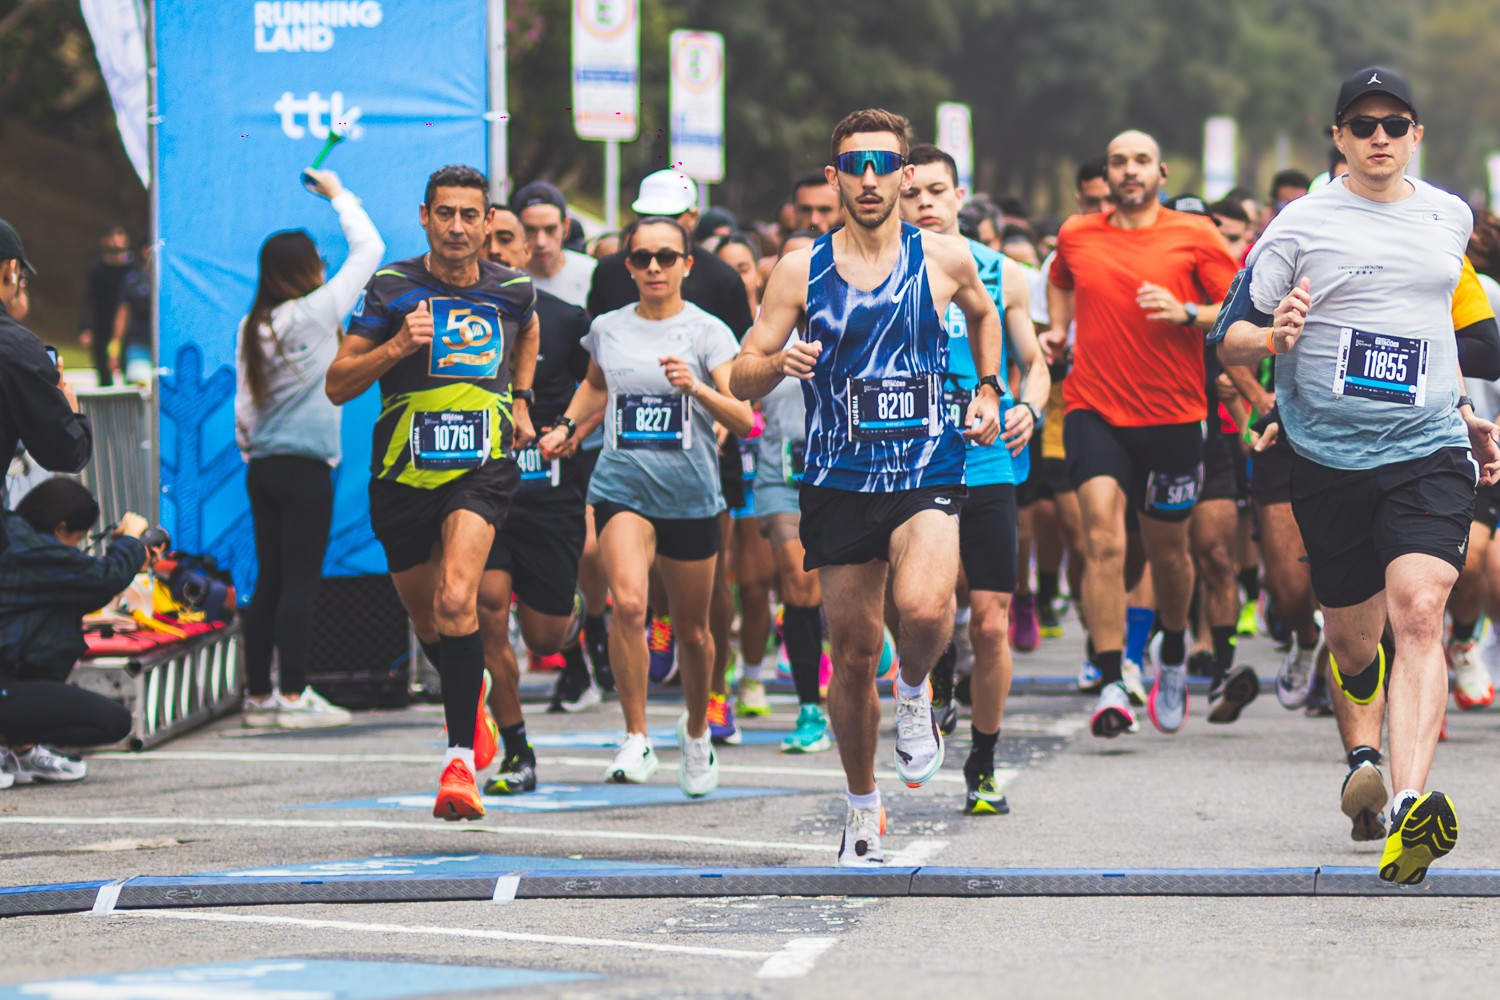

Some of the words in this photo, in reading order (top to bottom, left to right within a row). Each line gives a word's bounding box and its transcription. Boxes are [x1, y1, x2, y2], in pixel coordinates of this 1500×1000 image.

[254, 0, 383, 29] RUNNING
[254, 27, 335, 53] LAND
[274, 91, 365, 140] ttk
[442, 309, 493, 350] 50
[1364, 349, 1409, 382] 11855
[635, 407, 672, 432] 8227
[877, 391, 915, 420] 8210
[433, 424, 475, 451] 10761
